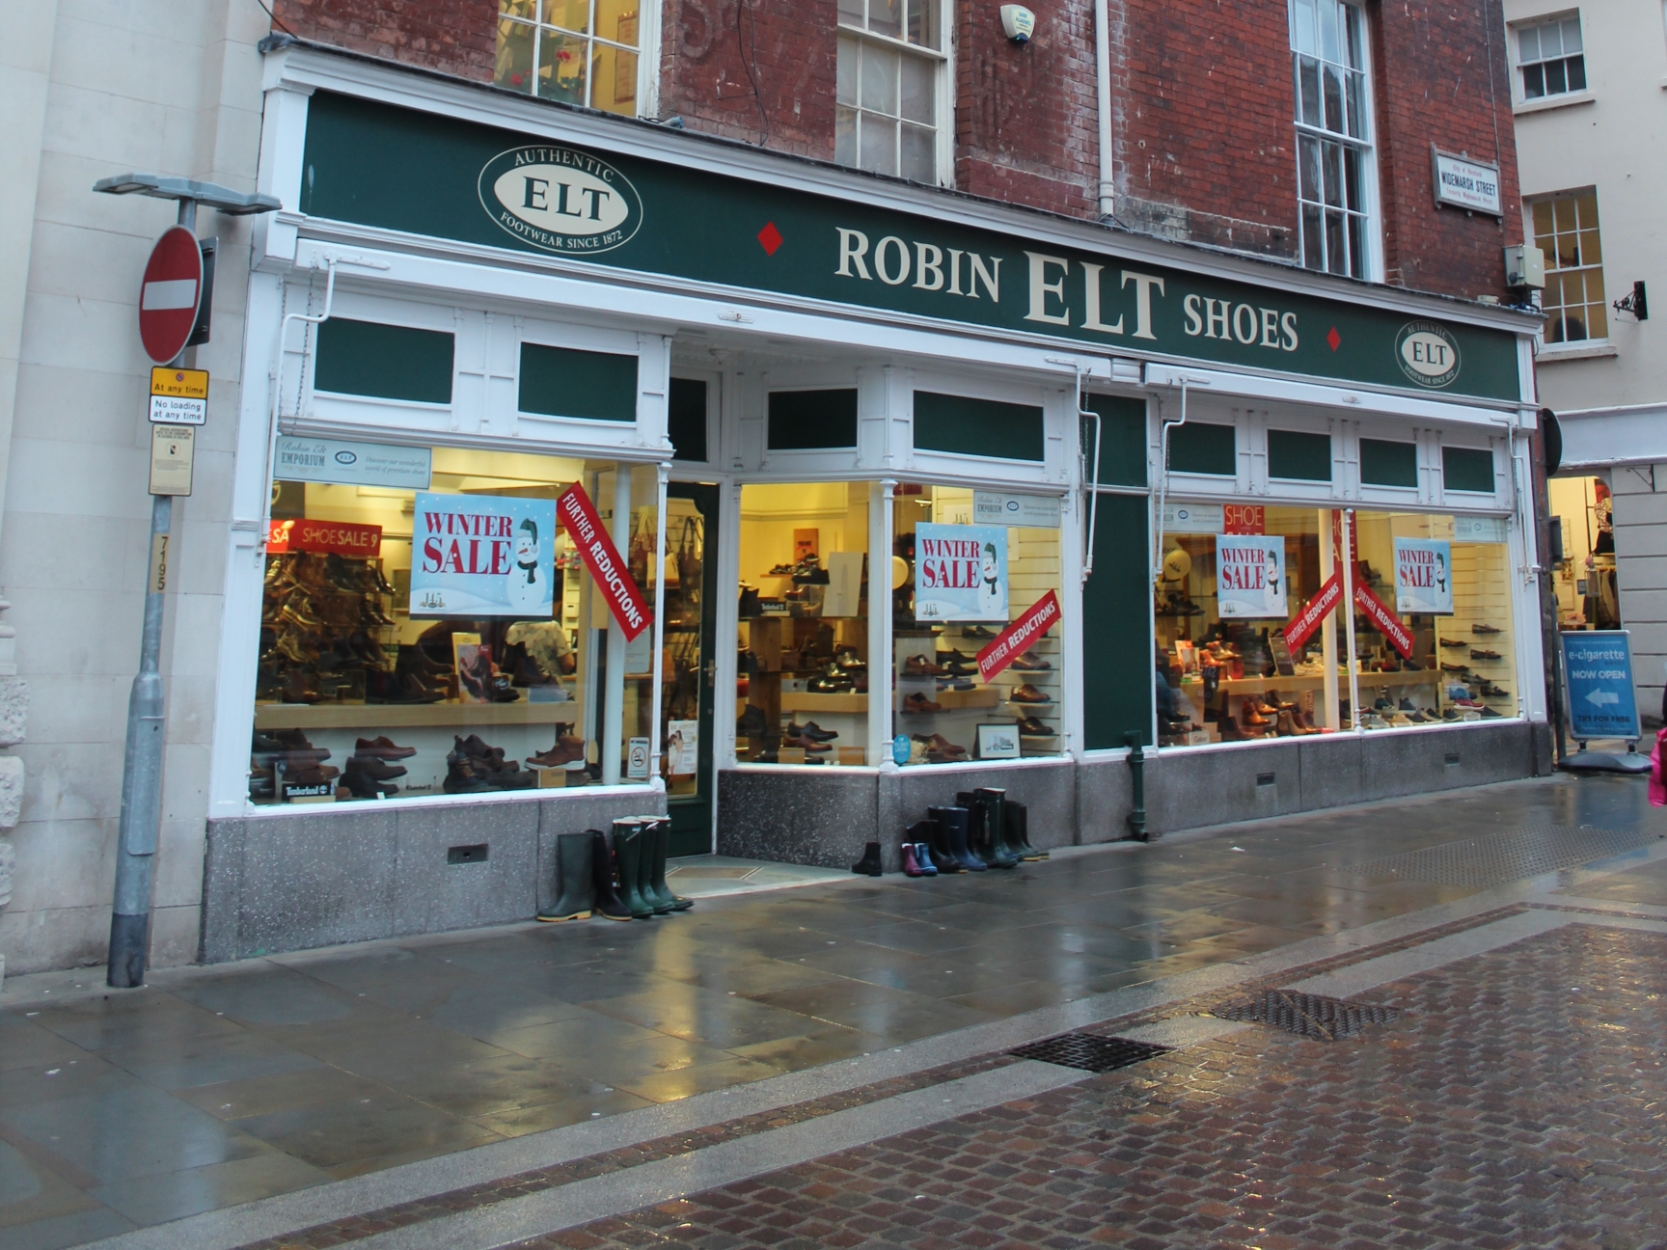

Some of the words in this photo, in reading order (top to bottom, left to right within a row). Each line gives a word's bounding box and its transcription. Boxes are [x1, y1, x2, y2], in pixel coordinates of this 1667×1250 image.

[515, 149, 614, 182] AUTHENTIC
[1441, 171, 1474, 191] WIDEMARSH
[1476, 180, 1496, 196] STREET
[521, 175, 610, 222] ELT
[500, 211, 563, 247] FOOTWEAR
[567, 237, 600, 249] SINCE
[603, 230, 623, 245] 1872
[833, 226, 1003, 303] ROBIN
[1023, 251, 1165, 341] ELT
[1183, 294, 1299, 352] SHOES
[1412, 341, 1447, 366] ELT
[154, 383, 164, 391] At
[168, 386, 182, 394] any
[186, 385, 204, 394] time
[155, 400, 167, 408] No
[171, 401, 201, 412] loading
[183, 412, 202, 420] time
[281, 452, 325, 467] EMPORIUM
[423, 512, 513, 538] WINTER
[1225, 505, 1262, 526] SHOE
[422, 537, 512, 575] SALE
[562, 492, 595, 544] FURTHER
[589, 540, 643, 630] REDUCTIONS
[922, 539, 980, 559] WINTER
[1221, 548, 1265, 564] WINTER
[1398, 549, 1434, 564] WINTER
[922, 558, 980, 589] SALE
[1222, 565, 1266, 590] SALE
[1399, 564, 1435, 587] SALE
[1286, 619, 1307, 646] FURTHER
[1304, 581, 1339, 625] REDUCTIONS
[1356, 587, 1377, 612] FURTHER
[1375, 608, 1410, 650] REDUCTIONS
[981, 642, 1009, 674] FURTHER
[1007, 600, 1056, 649] REDUCTIONS
[1568, 649, 1625, 662] e-cigarette
[1572, 670, 1597, 679] NOW
[1598, 670, 1626, 679] OPEN
[285, 785, 319, 796] Timberland
